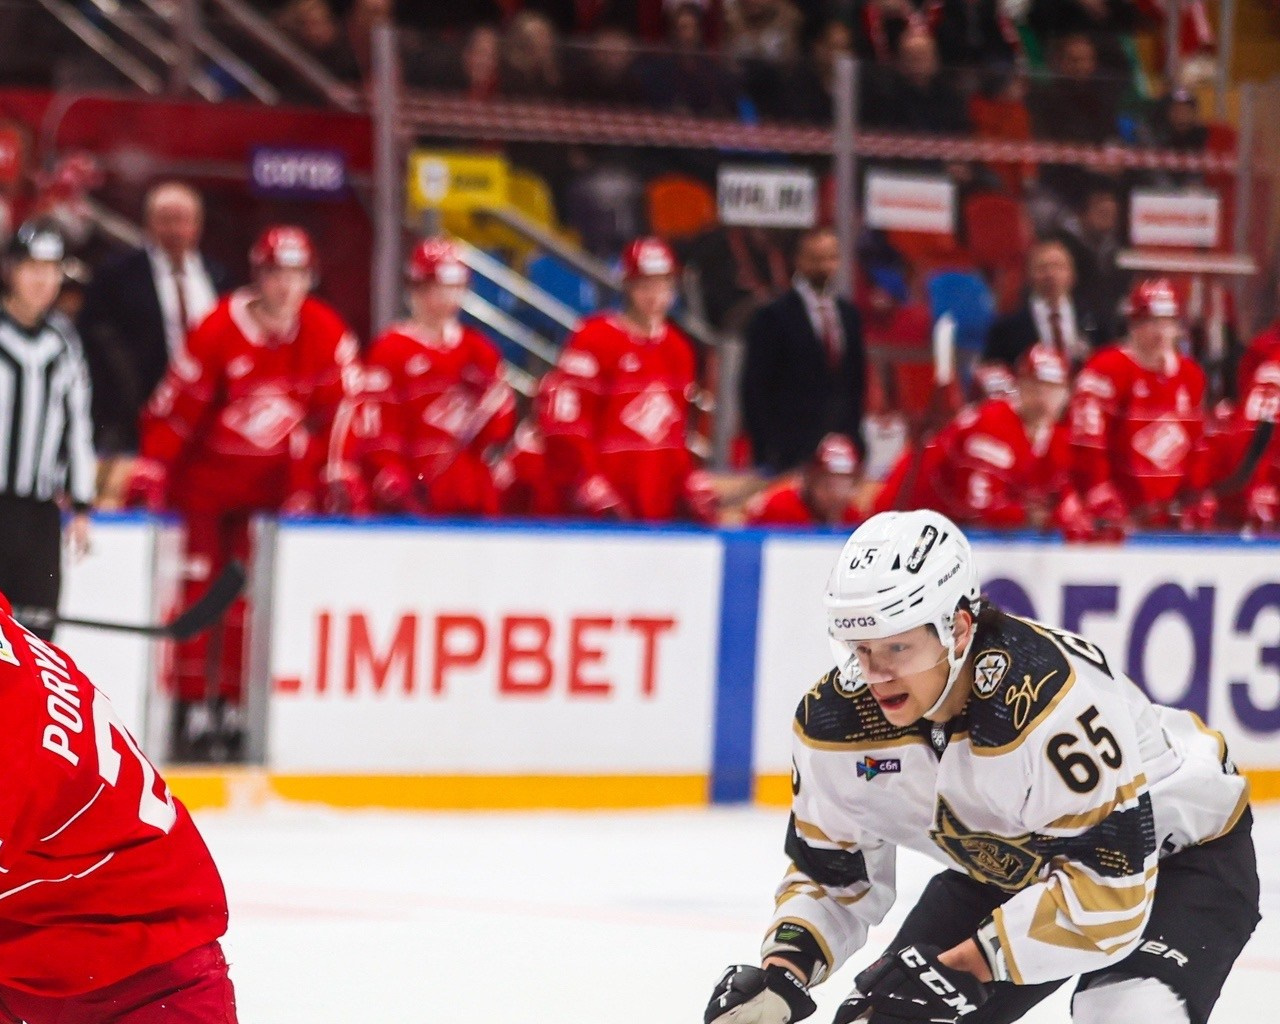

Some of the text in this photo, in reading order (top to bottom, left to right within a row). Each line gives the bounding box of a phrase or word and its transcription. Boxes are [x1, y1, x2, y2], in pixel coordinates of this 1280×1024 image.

[1046, 704, 1123, 794] 65
[901, 945, 978, 1016] CCM
[1139, 939, 1189, 968] ER
